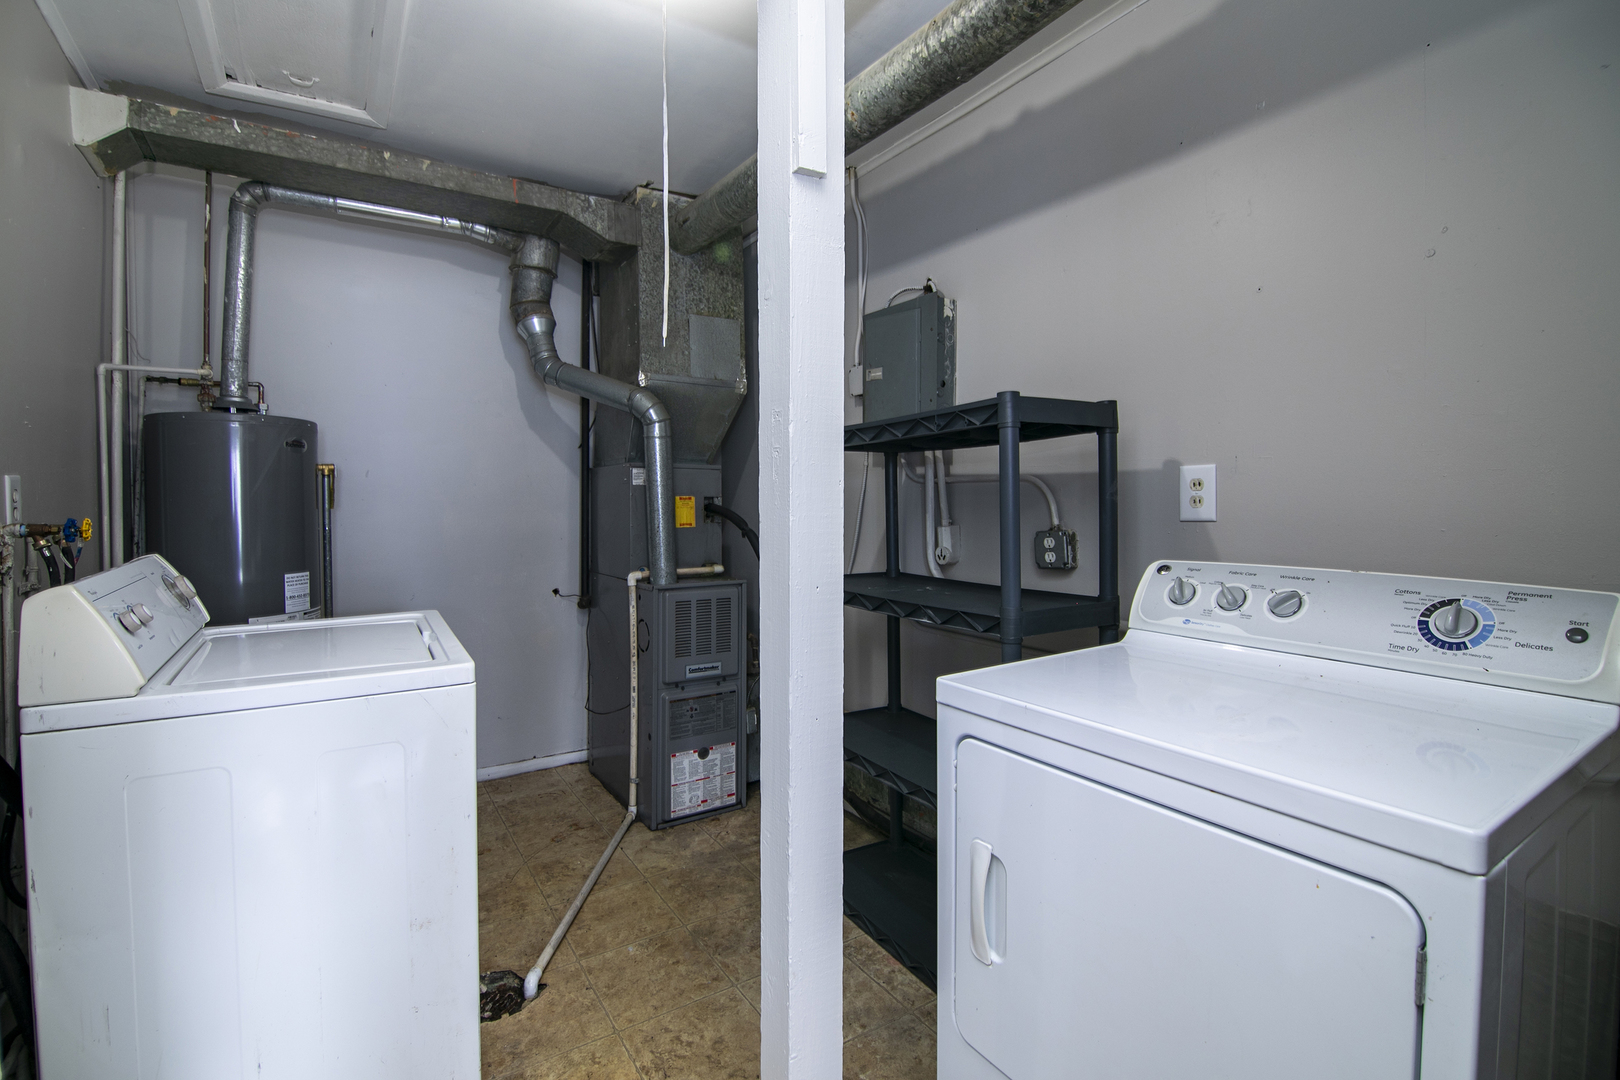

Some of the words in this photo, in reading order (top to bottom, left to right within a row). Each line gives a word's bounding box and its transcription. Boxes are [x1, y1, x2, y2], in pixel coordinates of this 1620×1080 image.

[1508, 591, 1553, 599] Permanent
[1389, 643, 1406, 651] Time
[1406, 645, 1420, 653] Dry
[1514, 641, 1554, 652] Delicates
